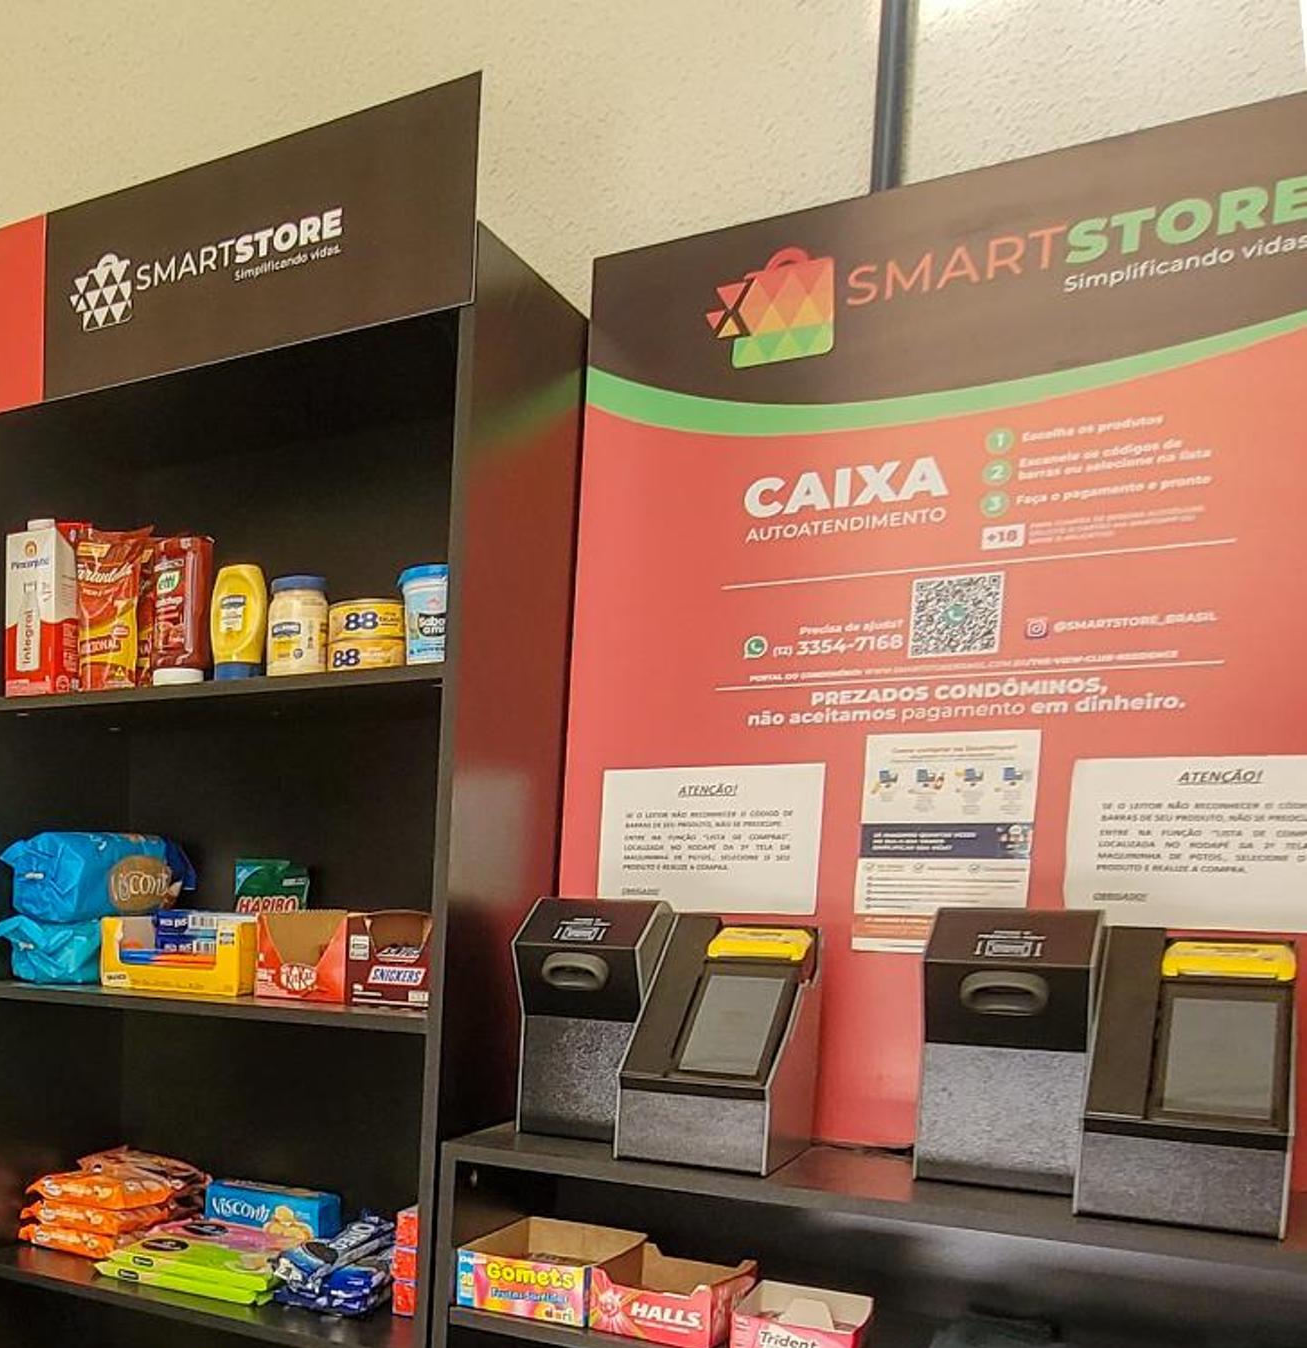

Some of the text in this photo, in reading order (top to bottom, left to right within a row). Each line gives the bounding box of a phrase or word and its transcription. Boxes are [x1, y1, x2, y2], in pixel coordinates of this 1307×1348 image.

[136, 208, 343, 291] SMARTSTORE
[846, 175, 1307, 305] SMARTSTORE
[235, 252, 308, 281] Simplificando
[1063, 249, 1235, 293] Simplificando
[1023, 427, 1074, 442] Escolha
[1078, 424, 1095, 434] os
[1098, 415, 1165, 433] produtos
[1102, 441, 1160, 459] códigos
[1163, 438, 1183, 451] de
[990, 448, 1212, 480] 2 barras ou selecione na lista
[744, 456, 950, 518] CAIXA
[1017, 495, 1048, 506] Faça
[1051, 491, 1061, 501] o
[1063, 481, 1145, 502] pagamento
[1148, 480, 1157, 490] e
[1160, 474, 1213, 491] pronto
[745, 507, 947, 543] AUTOATENDIMENTO
[799, 618, 904, 636] Precisa de ajuda?
[1053, 611, 1218, 633] @SMARTSTORE_BRASIL
[23, 609, 33, 664] Integral
[797, 633, 904, 656] 3354-7168
[811, 678, 1109, 706] PREZADOS CONDÔMINOS,
[747, 692, 1186, 726] não aceitamos pagamento em dinheiro.
[1178, 769, 1263, 786] ATENÇÃO!
[678, 784, 738, 797] ATENÇÃO!
[1101, 814, 1137, 822] BARRAS
[1140, 814, 1151, 822] DE
[1155, 814, 1172, 822] SEU
[1229, 813, 1251, 822] NÃO
[1168, 801, 1189, 809] NÃO
[1161, 828, 1201, 838] FUNÇÃO
[1096, 864, 1142, 872] PRODUTO
[1097, 852, 1161, 860] MAQUININHA
[238, 896, 299, 913] HARIBO
[372, 968, 422, 983] SNICKERS
[211, 1197, 271, 1223] Visconti
[485, 1262, 575, 1290] Gomets
[630, 1301, 700, 1326] HALLS
